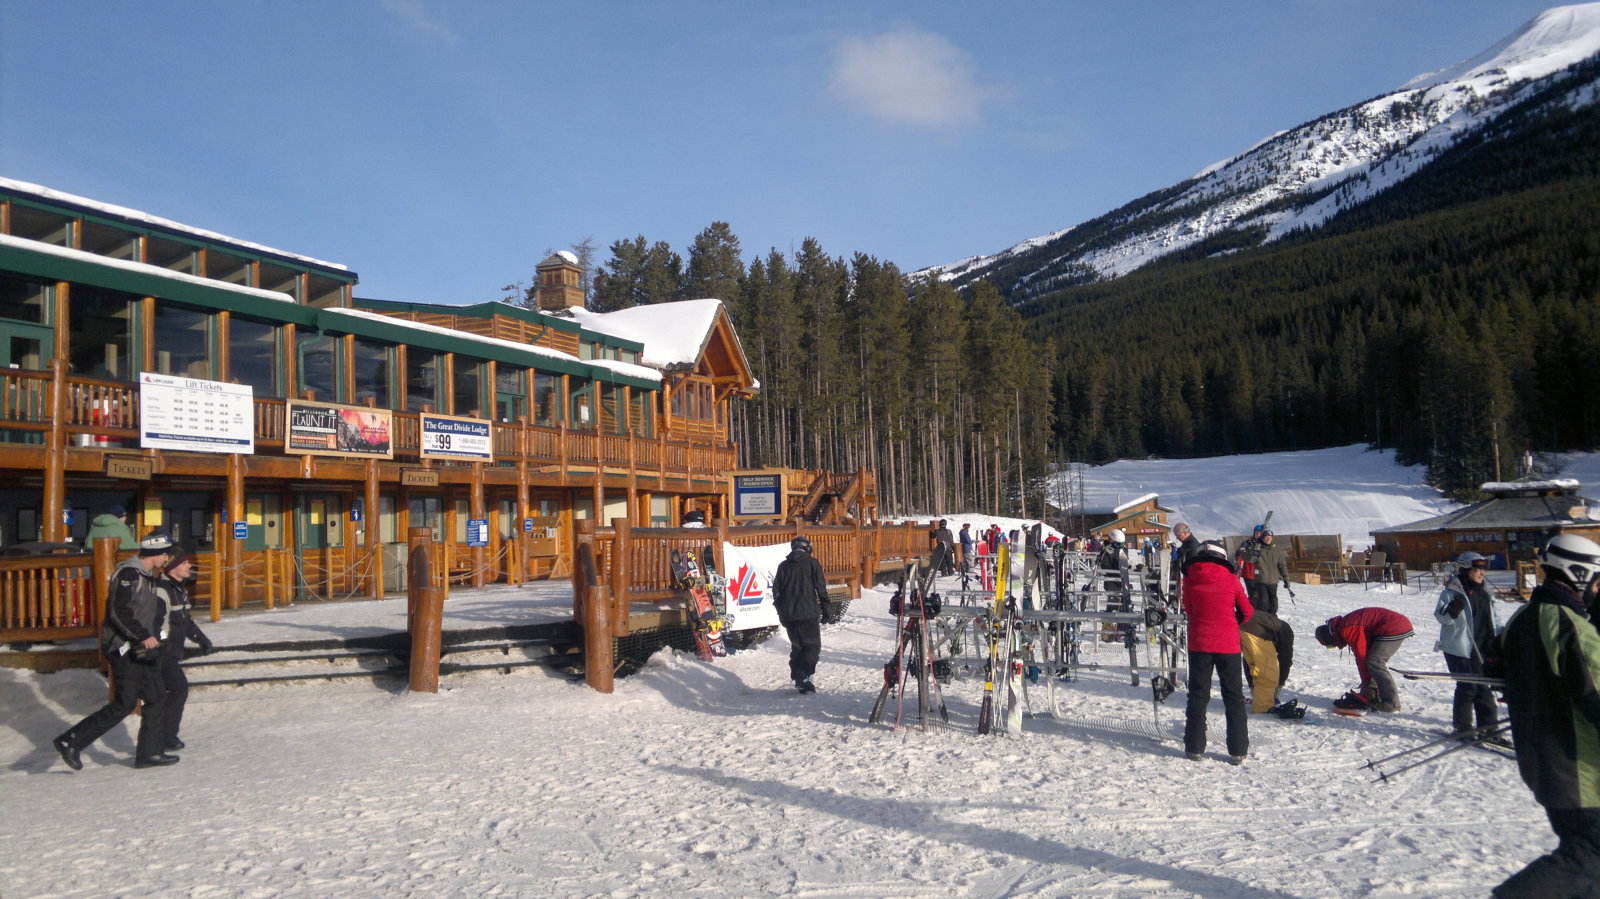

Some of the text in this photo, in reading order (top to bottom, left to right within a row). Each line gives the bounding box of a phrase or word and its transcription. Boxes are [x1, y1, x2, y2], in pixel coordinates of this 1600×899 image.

[185, 380, 222, 391] Lift Tickets
[425, 420, 487, 436] The Great Divide Lodge
[435, 434, 452, 450] $99
[113, 464, 146, 476] TICKETS
